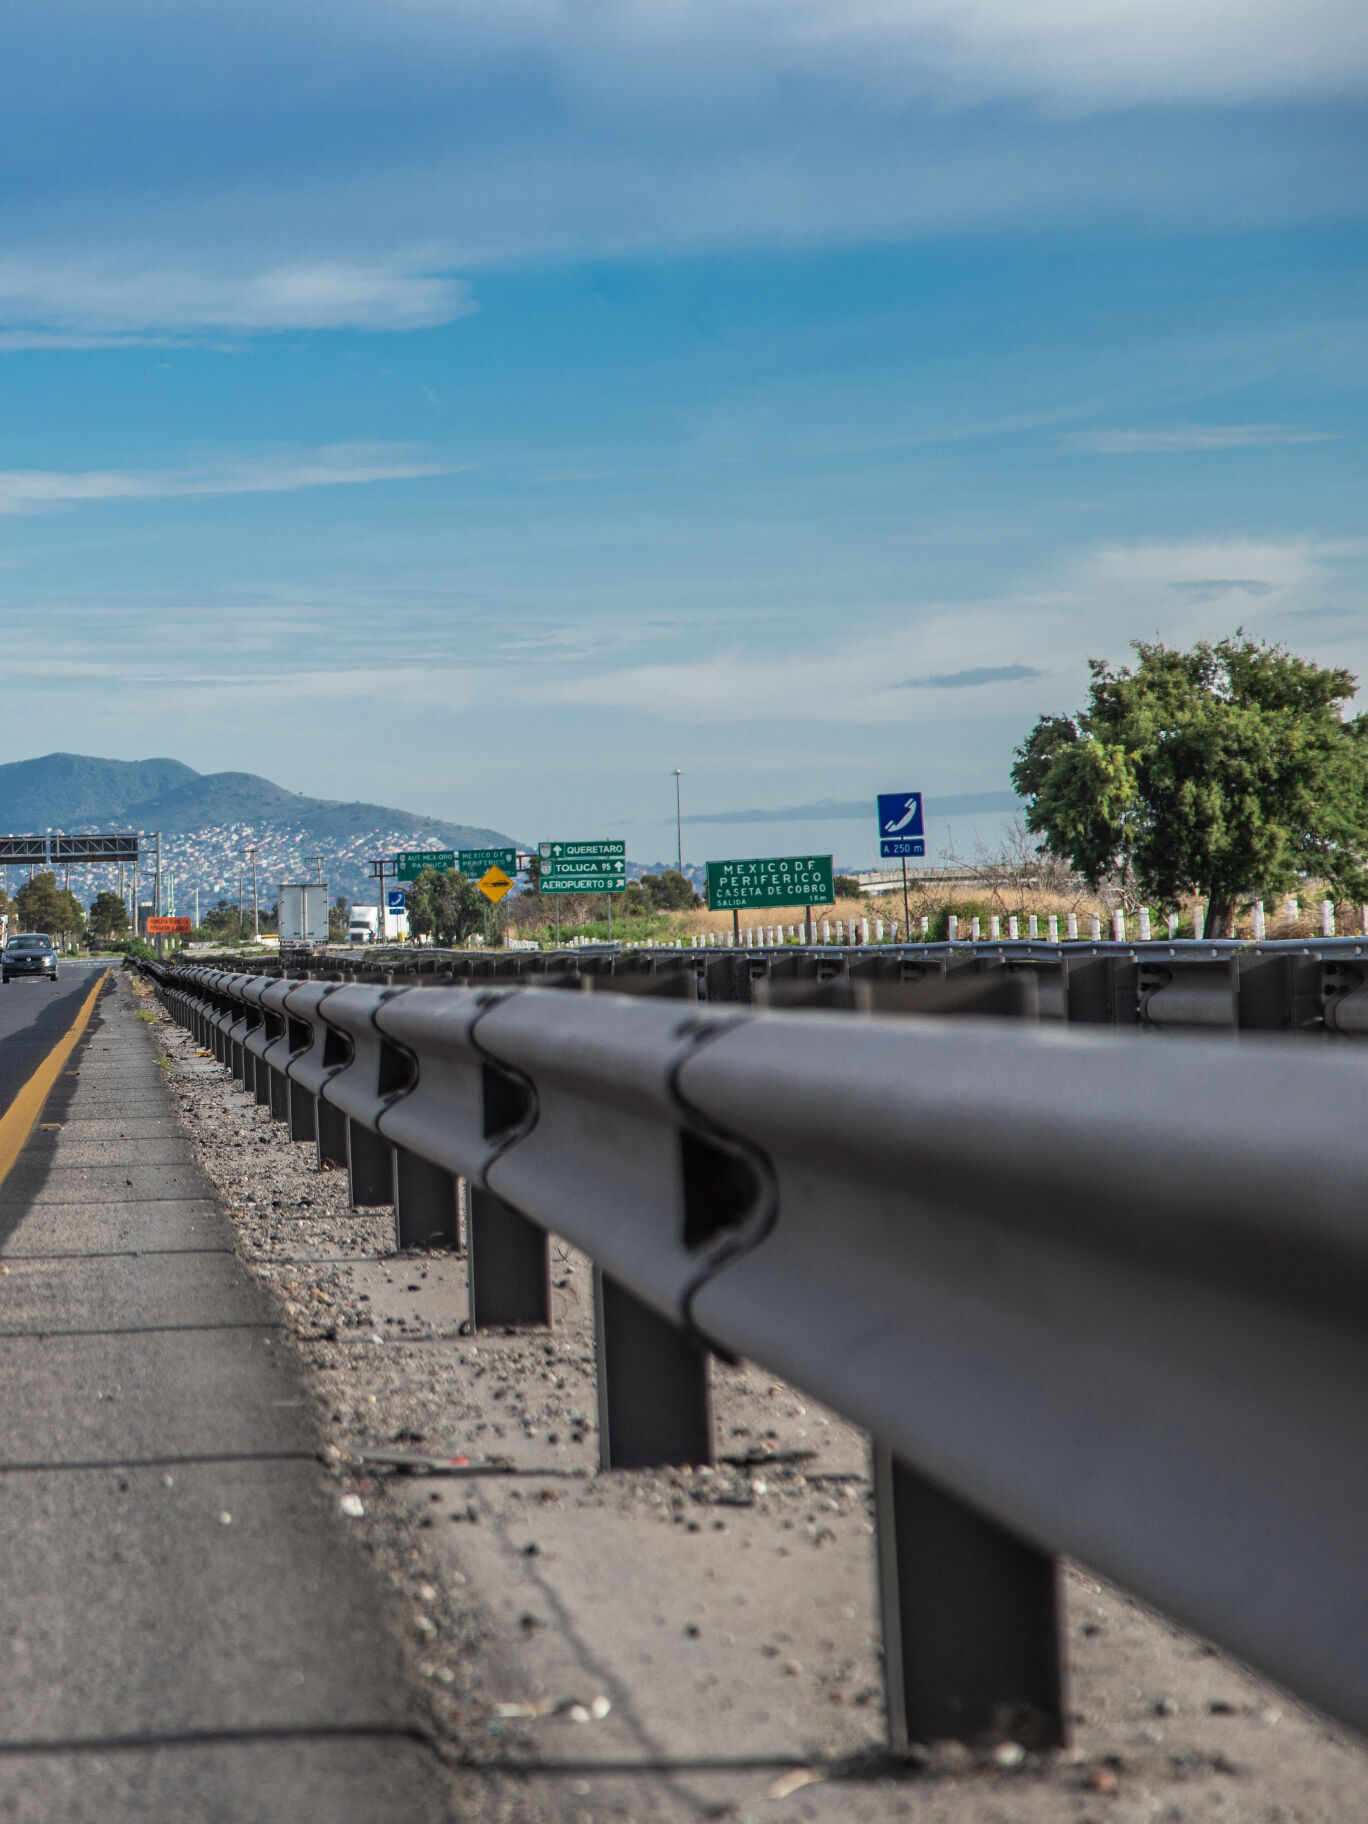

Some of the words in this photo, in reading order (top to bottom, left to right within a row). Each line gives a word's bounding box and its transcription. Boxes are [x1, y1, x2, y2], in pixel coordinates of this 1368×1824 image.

[566, 845, 623, 855] QUERETARO
[884, 845, 890, 854] A
[894, 844, 911, 853] 250
[913, 845, 923, 853] m
[555, 863, 598, 872] TOLUCA
[601, 863, 611, 871] 95
[723, 862, 788, 875] MEXICO
[542, 880, 605, 889] AEROPUERTO
[607, 880, 613, 888] 9
[719, 872, 822, 887] PERIFERICO
[716, 887, 762, 898] CASETA
[767, 886, 783, 895] DE
[787, 884, 826, 894] COBRO
[716, 898, 747, 907] SALIDA
